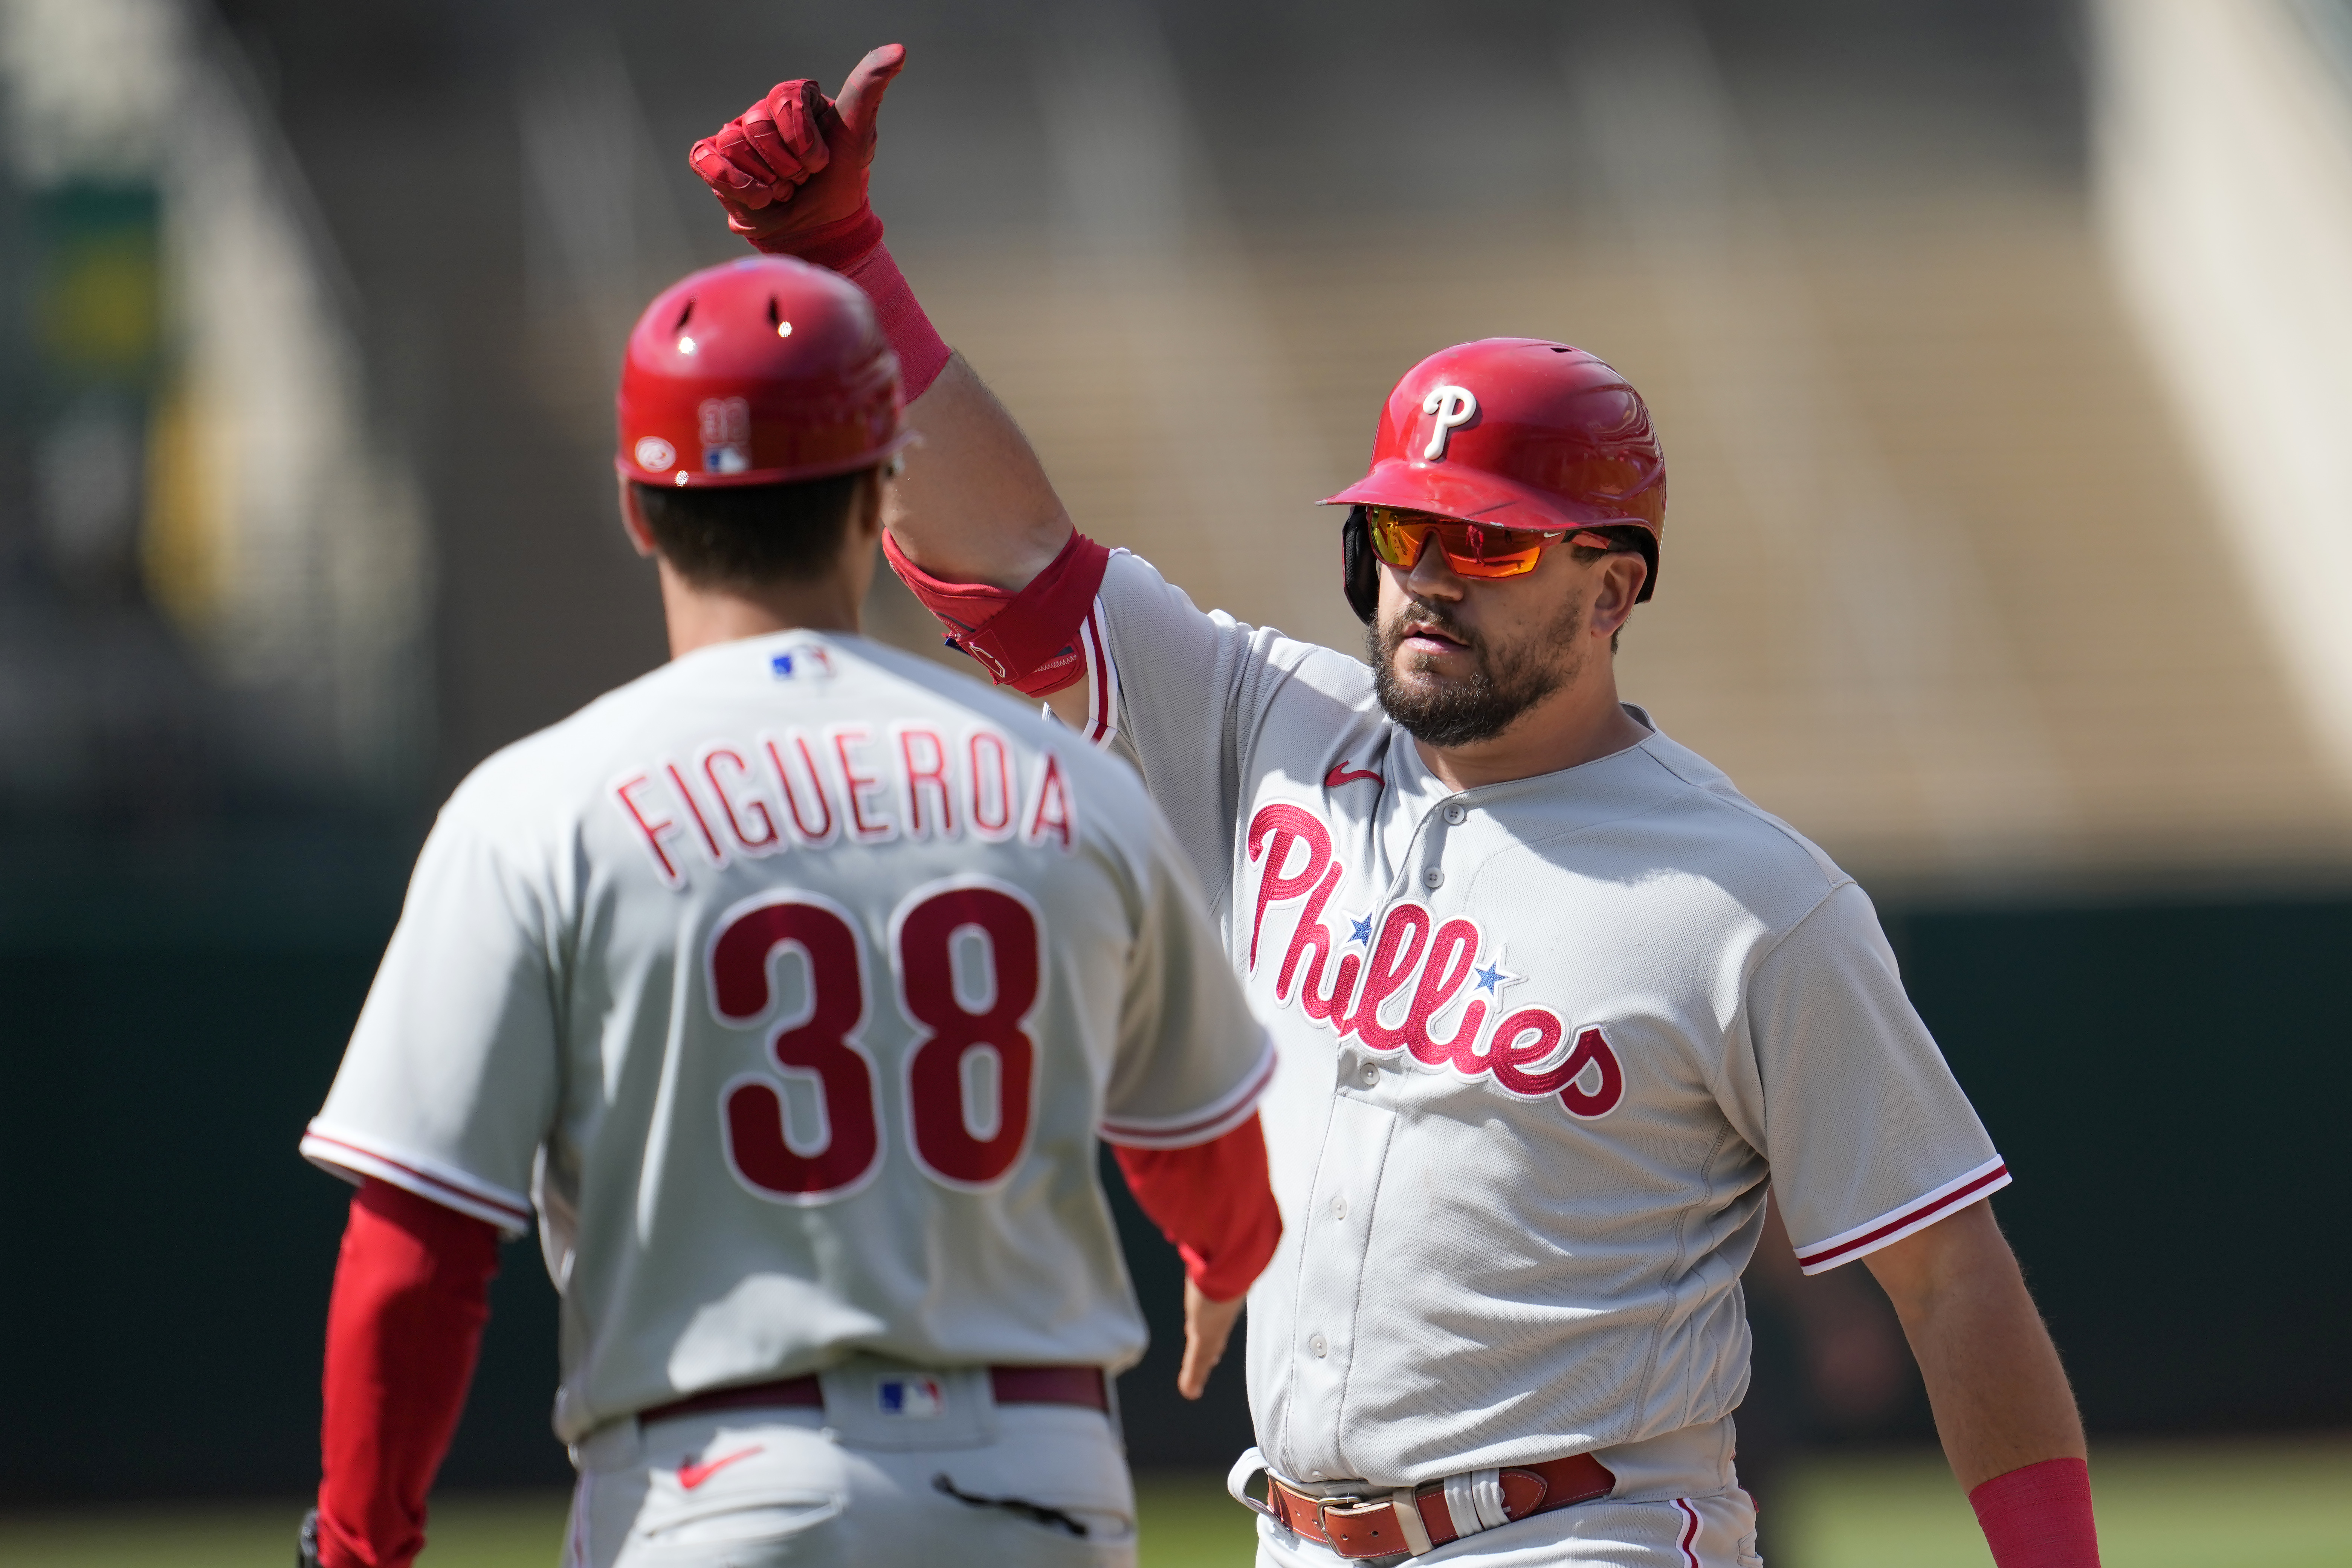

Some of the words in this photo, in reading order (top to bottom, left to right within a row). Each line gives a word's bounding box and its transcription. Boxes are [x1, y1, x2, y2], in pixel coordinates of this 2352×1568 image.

[1423, 385, 1477, 460] P
[614, 724, 1073, 881] FIGUEROA
[711, 885, 1040, 1198] 38
[1248, 803, 1622, 1117] Phillies
